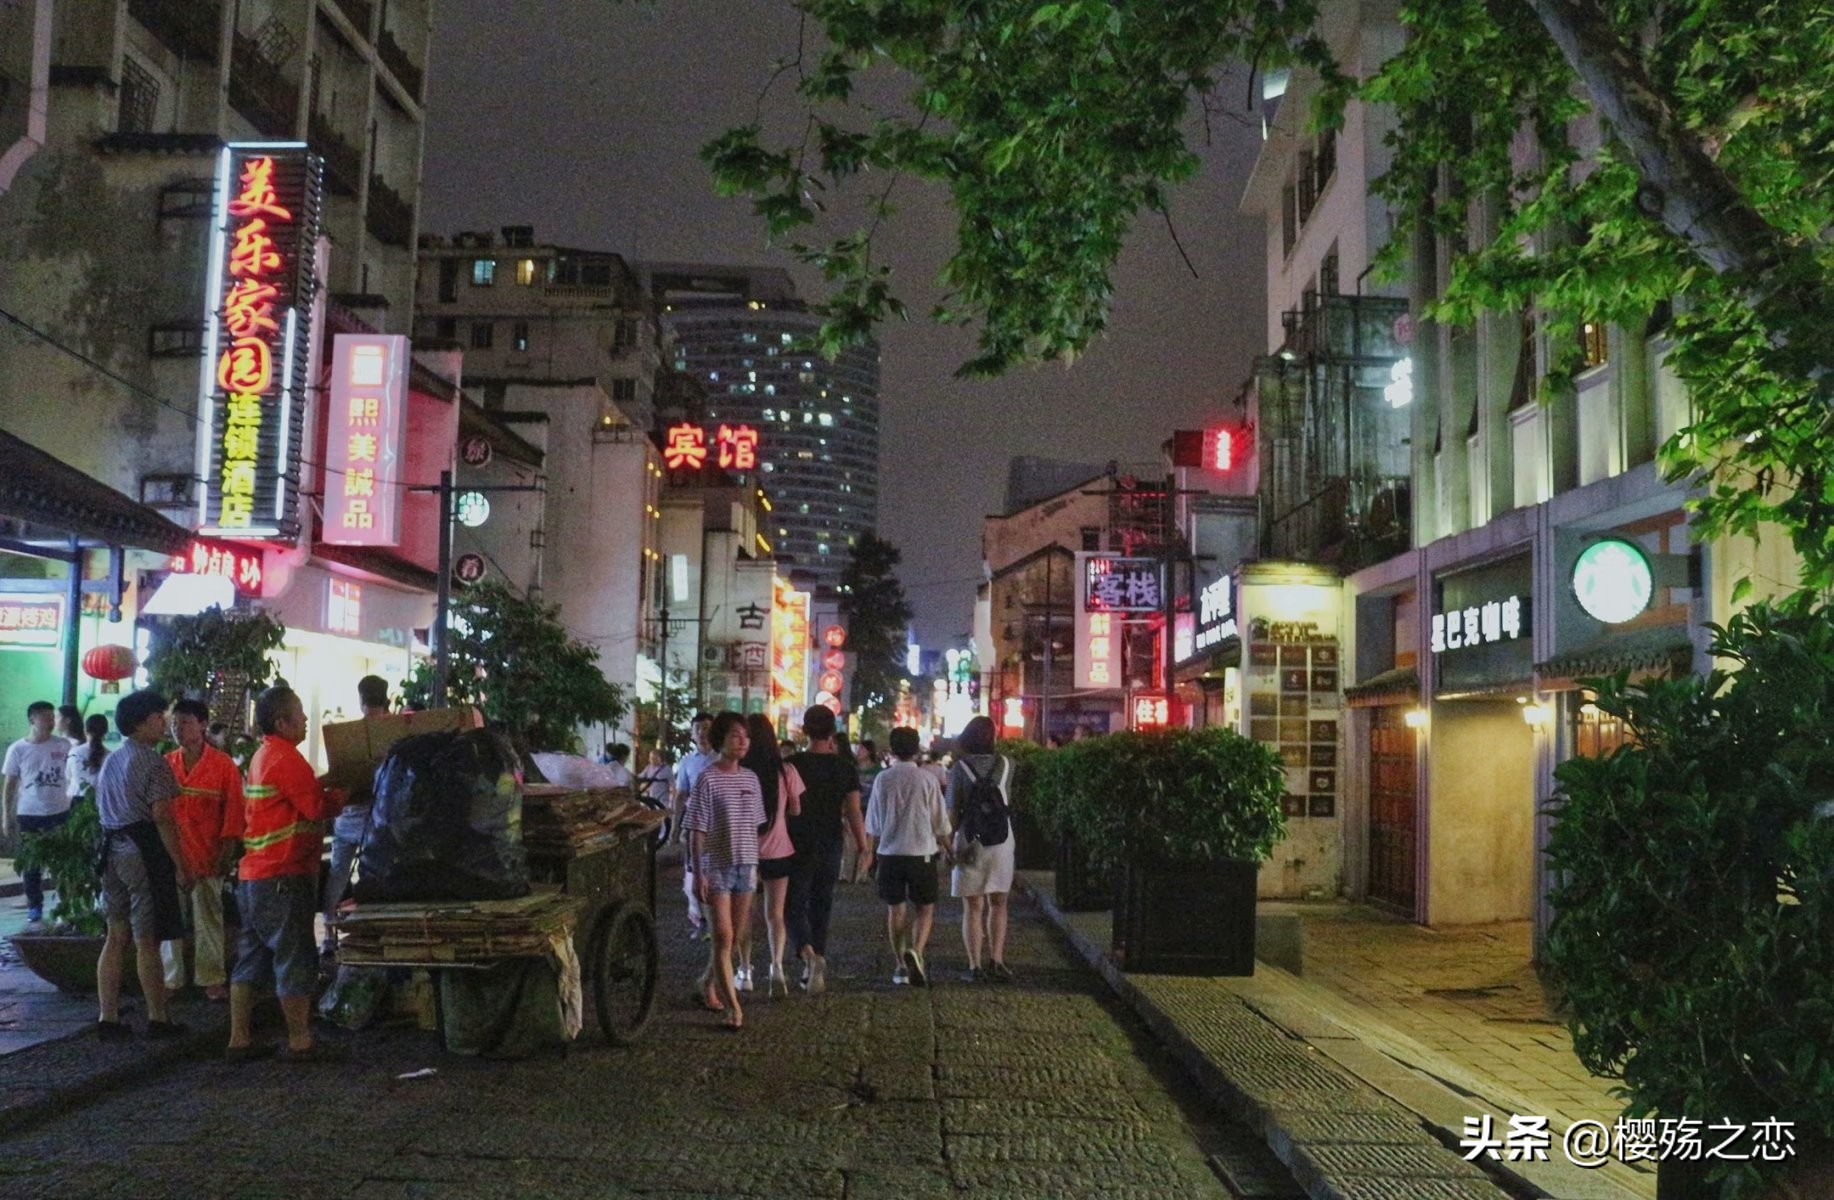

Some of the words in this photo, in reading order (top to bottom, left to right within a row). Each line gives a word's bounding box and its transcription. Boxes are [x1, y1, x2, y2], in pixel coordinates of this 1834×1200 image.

[218, 156, 291, 392] 美乐家园
[217, 393, 261, 528] 连锁酒店
[664, 422, 758, 469] 宾馆
[1095, 571, 1160, 607] 客栈
[1431, 594, 1520, 653] 星巴克咖啡
